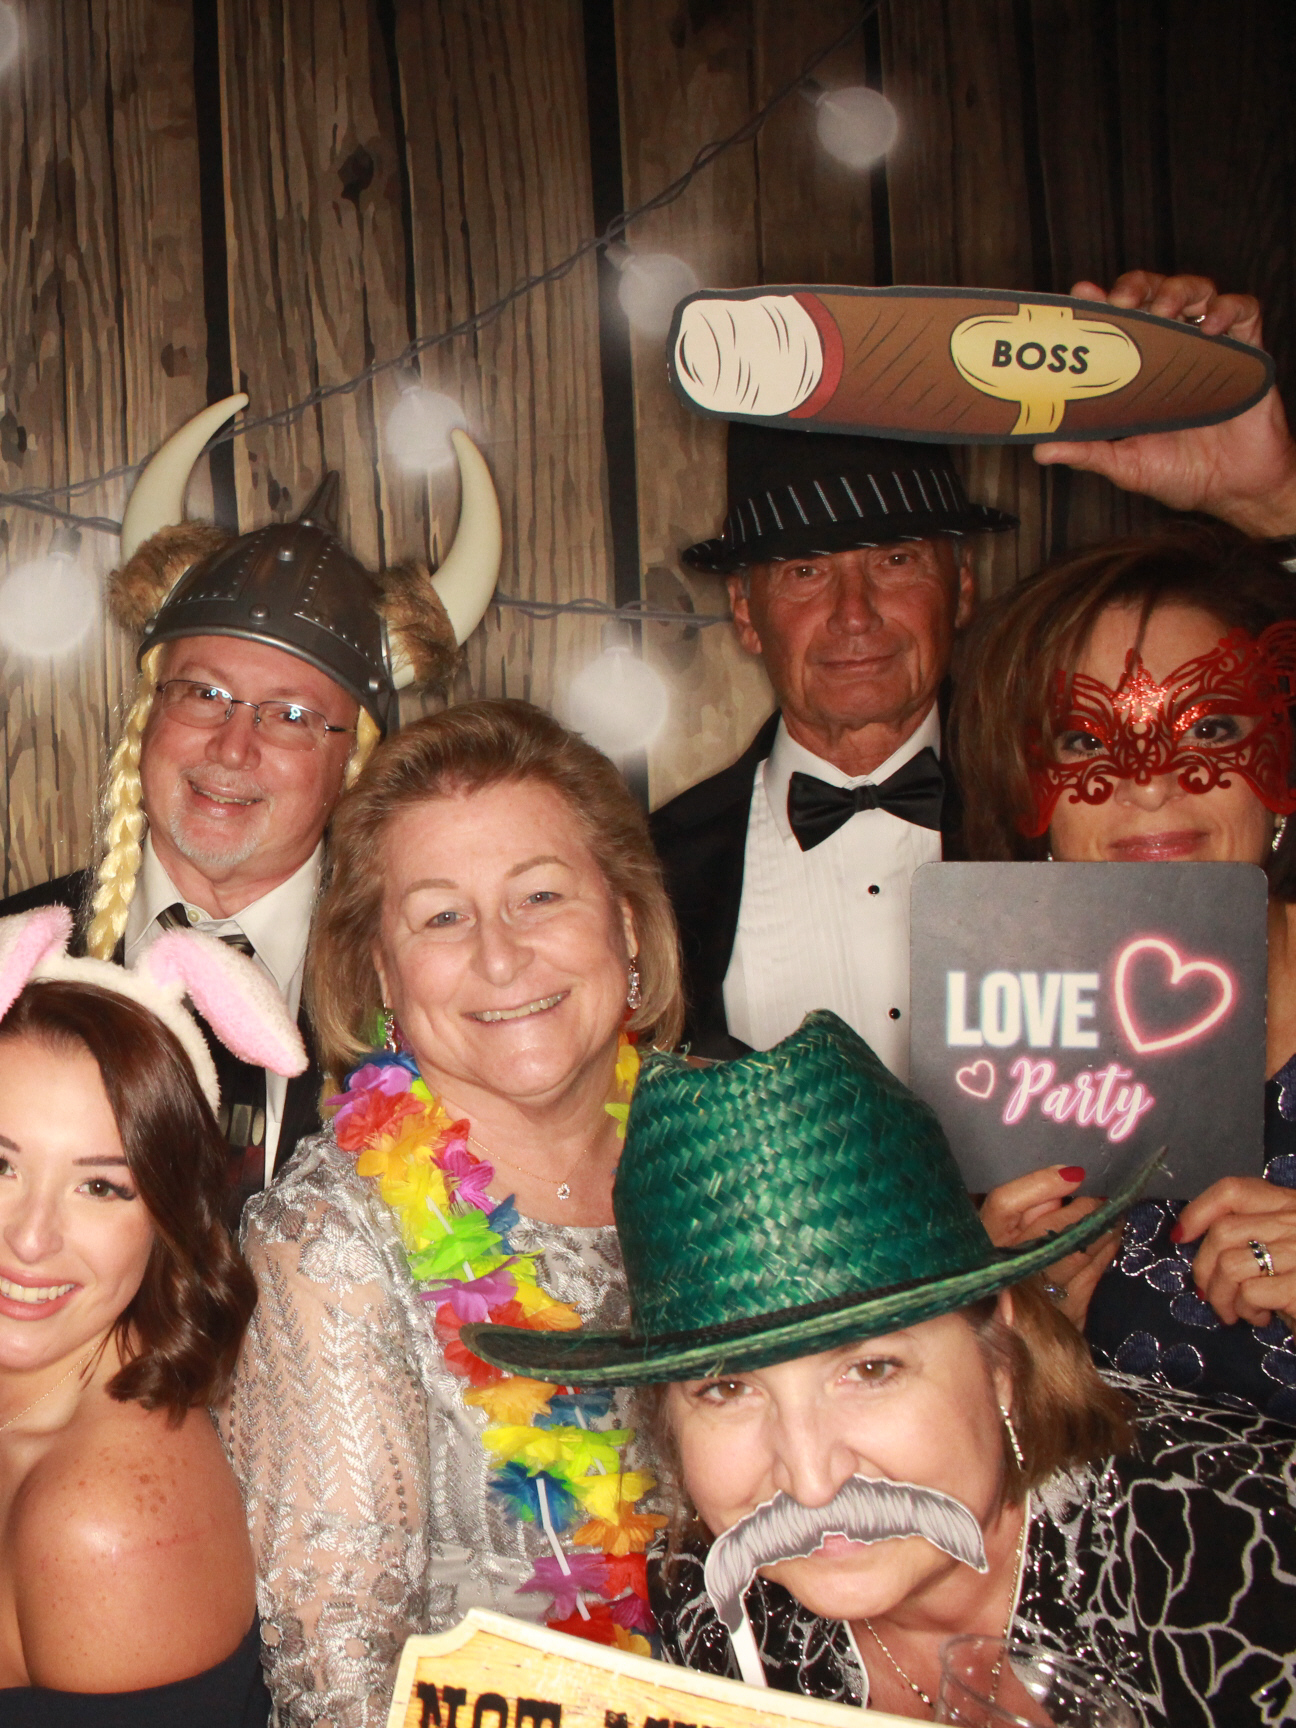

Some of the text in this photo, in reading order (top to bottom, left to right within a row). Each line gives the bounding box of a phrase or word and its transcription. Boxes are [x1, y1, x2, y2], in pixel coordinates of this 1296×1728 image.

[991, 339, 1090, 375] BOSS
[946, 969, 1100, 1049] LOVE
[1002, 1055, 1156, 1143] Party
